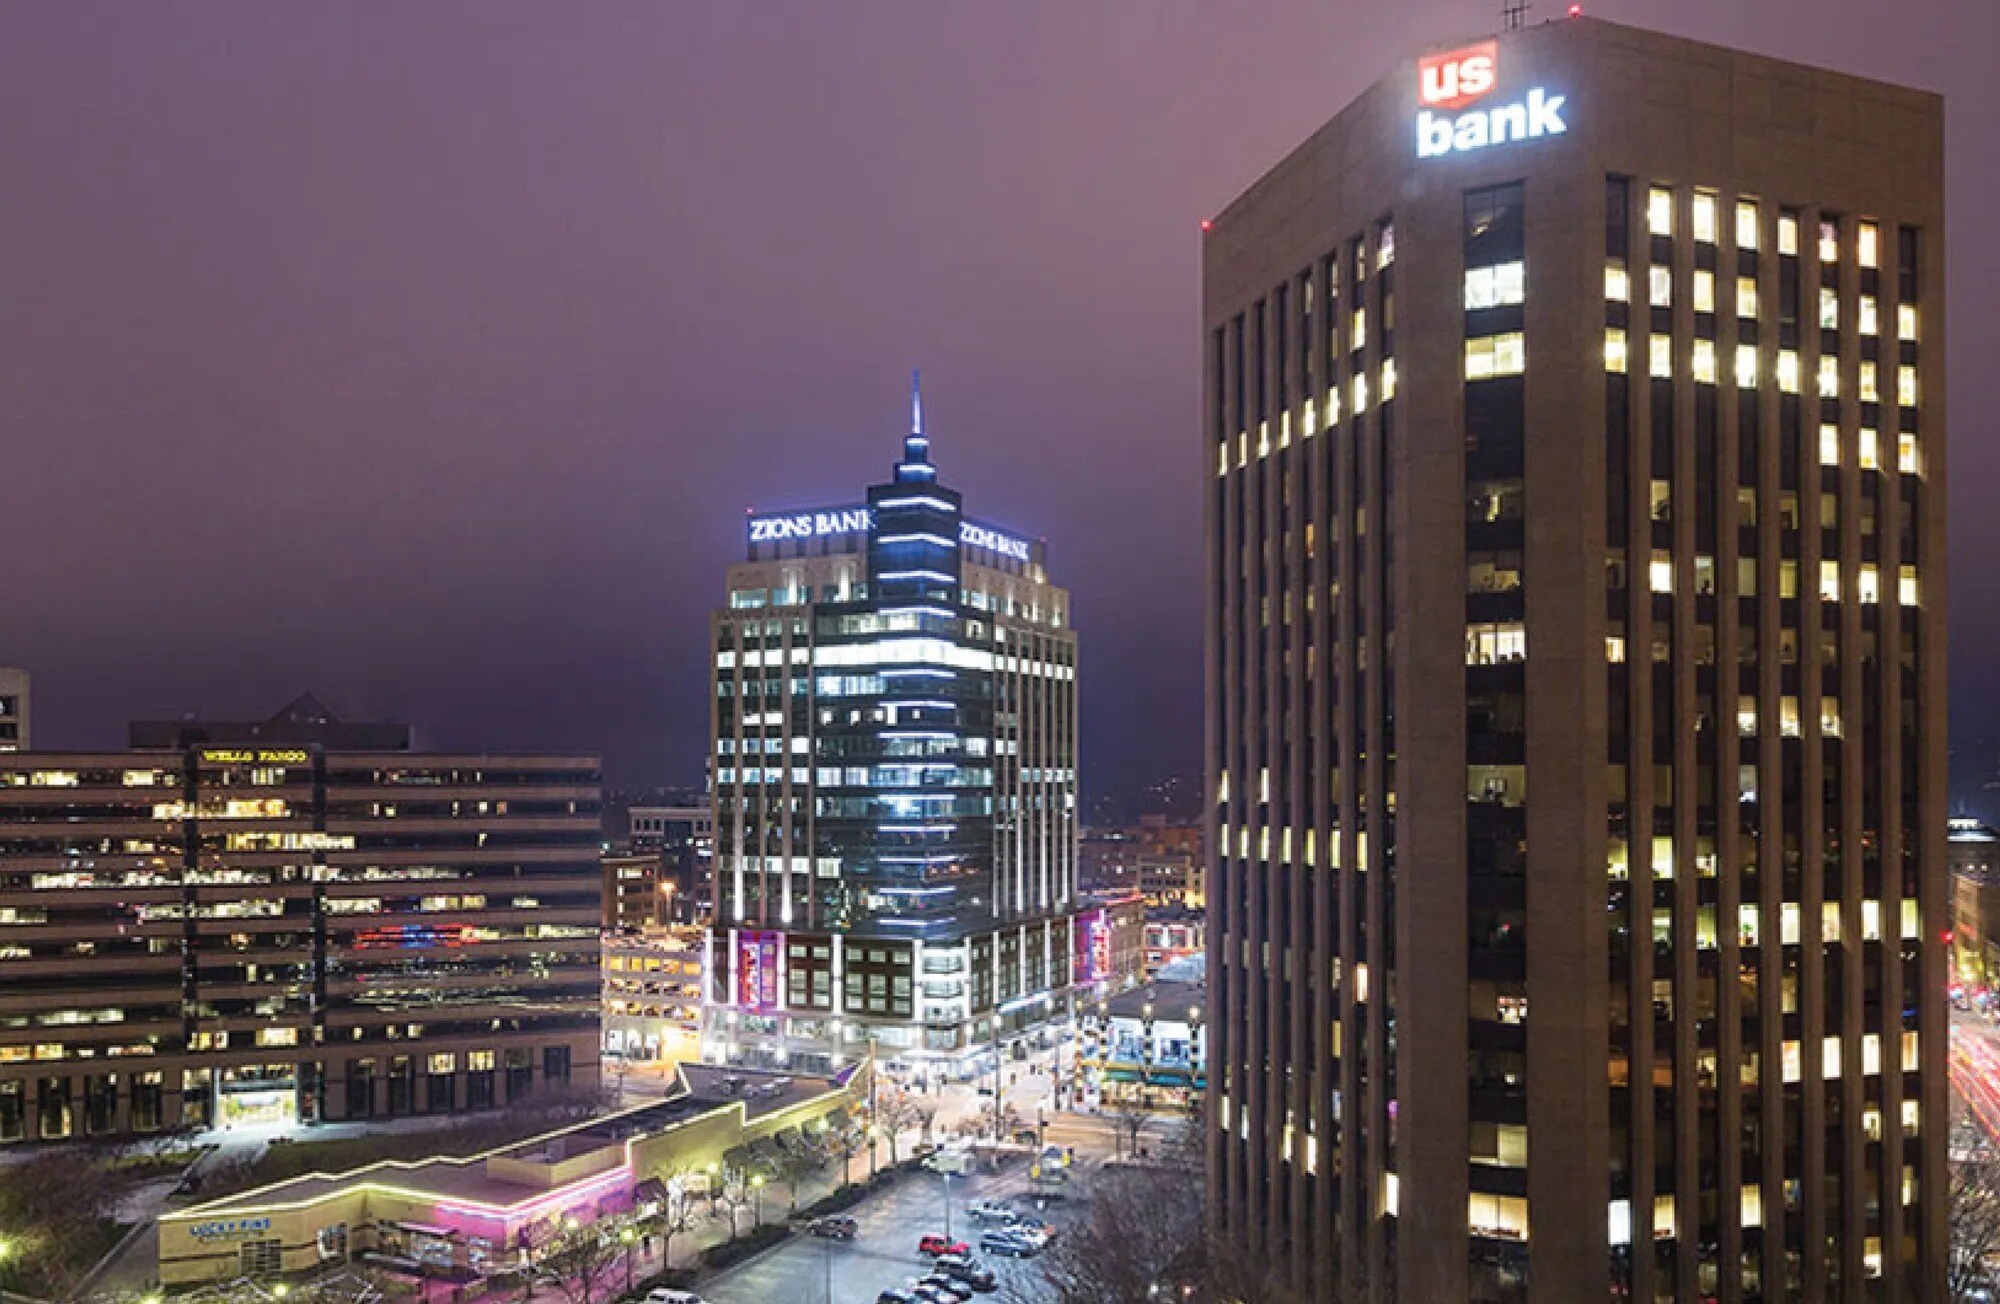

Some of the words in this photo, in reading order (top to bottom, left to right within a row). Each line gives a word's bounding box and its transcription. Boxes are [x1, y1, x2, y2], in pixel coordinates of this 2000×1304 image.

[1422, 56, 1494, 103] us
[1416, 86, 1567, 158] bank
[750, 516, 812, 541] ZIONS
[815, 509, 876, 535] BANK
